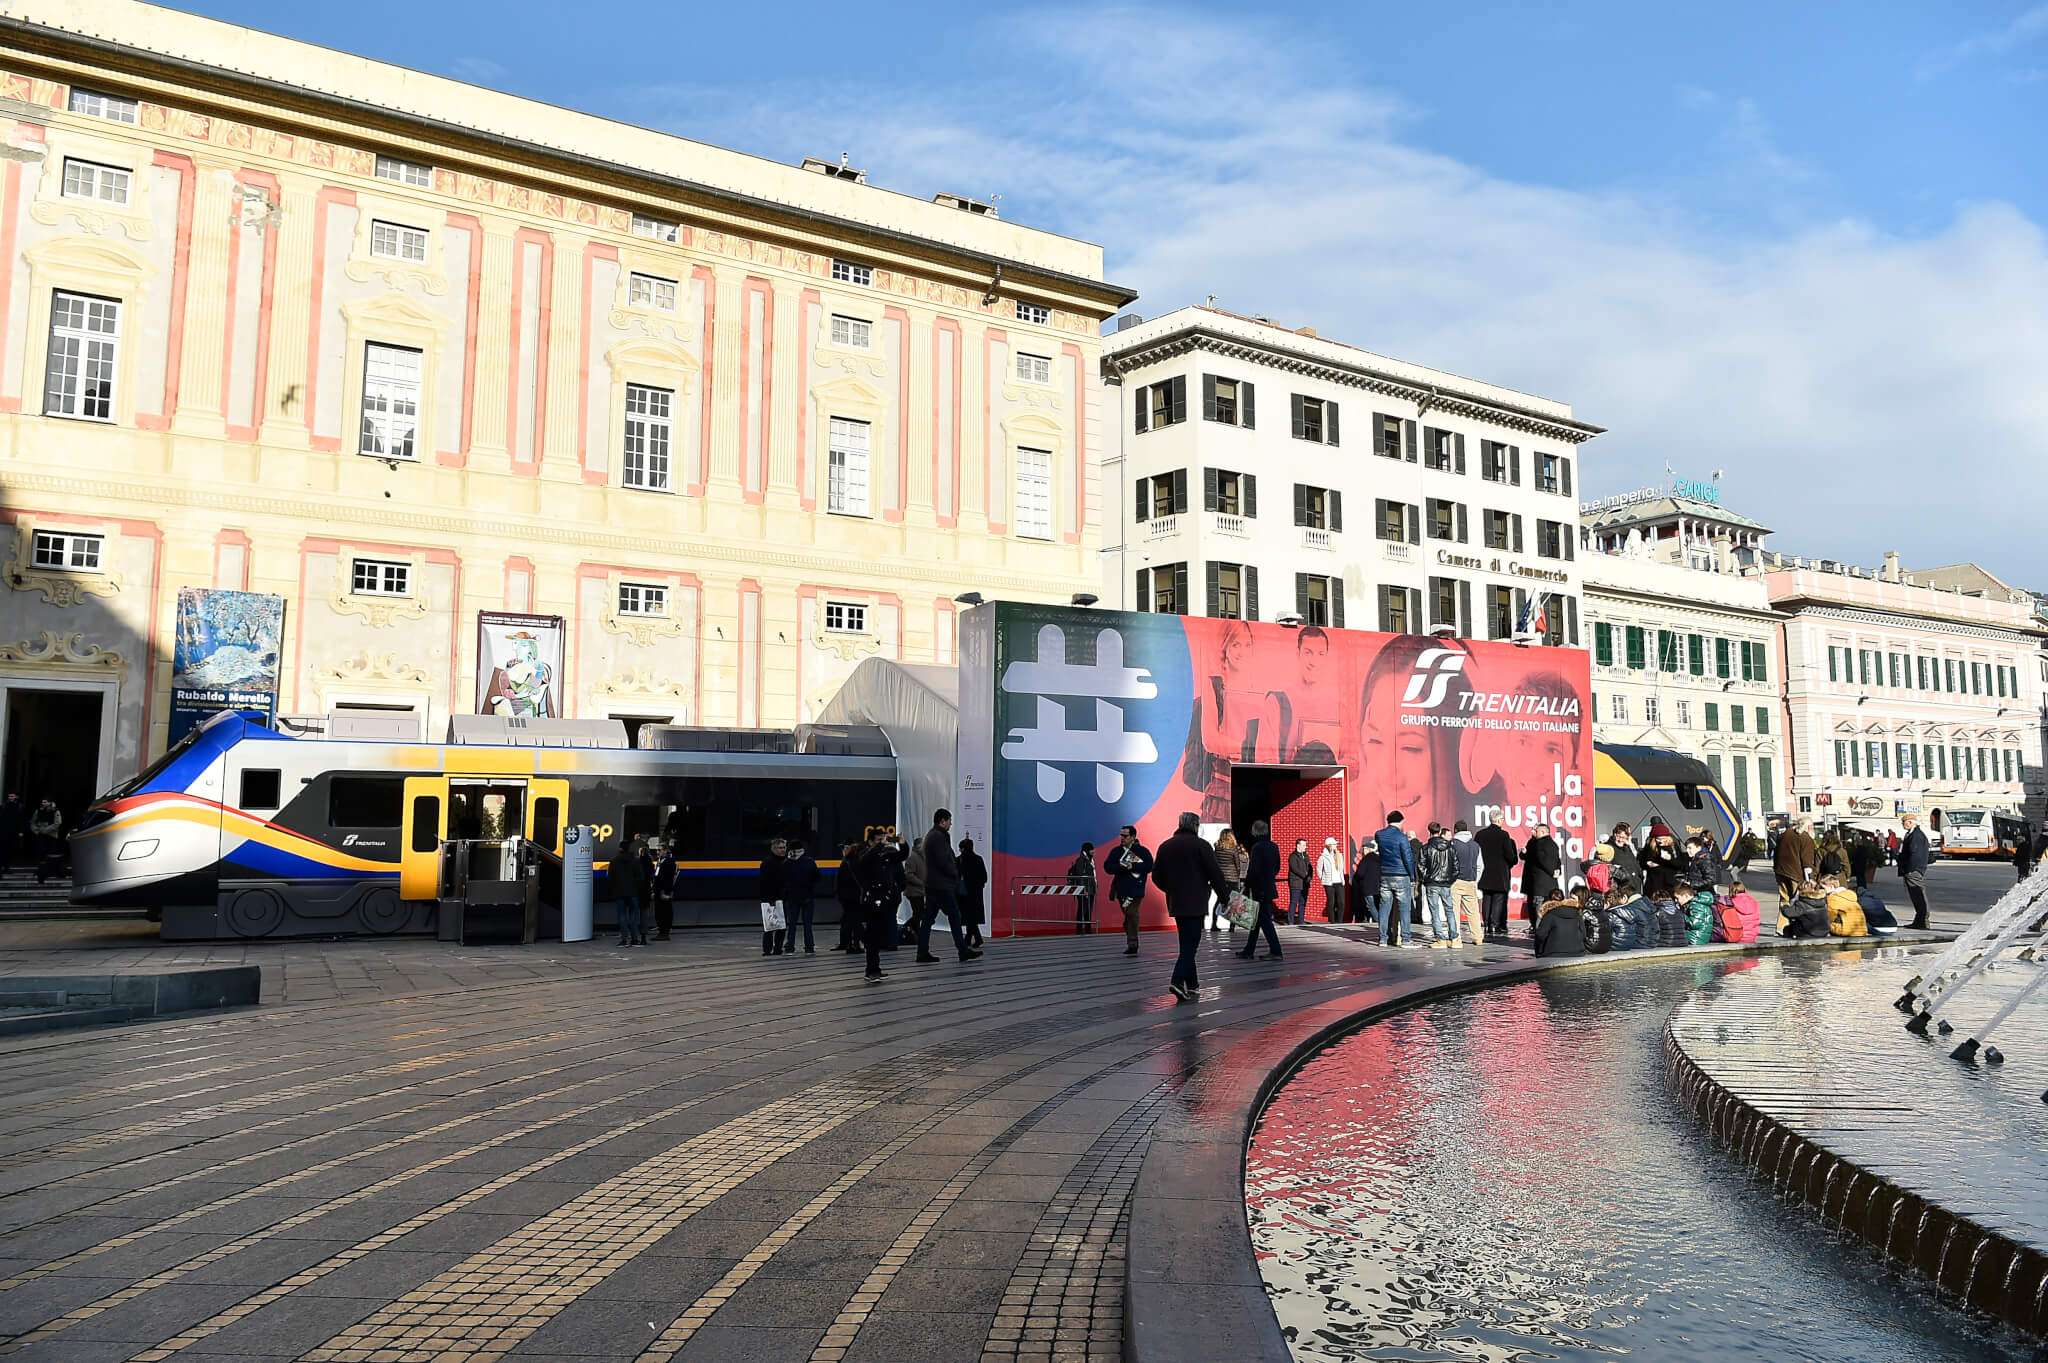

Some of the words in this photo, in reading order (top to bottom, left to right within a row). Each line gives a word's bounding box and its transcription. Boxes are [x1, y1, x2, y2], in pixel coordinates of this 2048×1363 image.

[1436, 549, 1482, 569] Camera
[1490, 558, 1501, 572] di
[1508, 561, 1569, 583] Commercio
[177, 690, 226, 702] Rubaldo
[228, 693, 272, 704] Merello
[1457, 691, 1580, 717] TRENITALIA
[1400, 714, 1440, 727] GRUPPO
[1441, 716, 1483, 729] FERROVIE
[1484, 718, 1512, 731] DELLO
[1513, 720, 1541, 732] STATO
[1542, 722, 1580, 734] ITALIANE
[1554, 762, 1583, 796] la
[1474, 795, 1583, 827] musica
